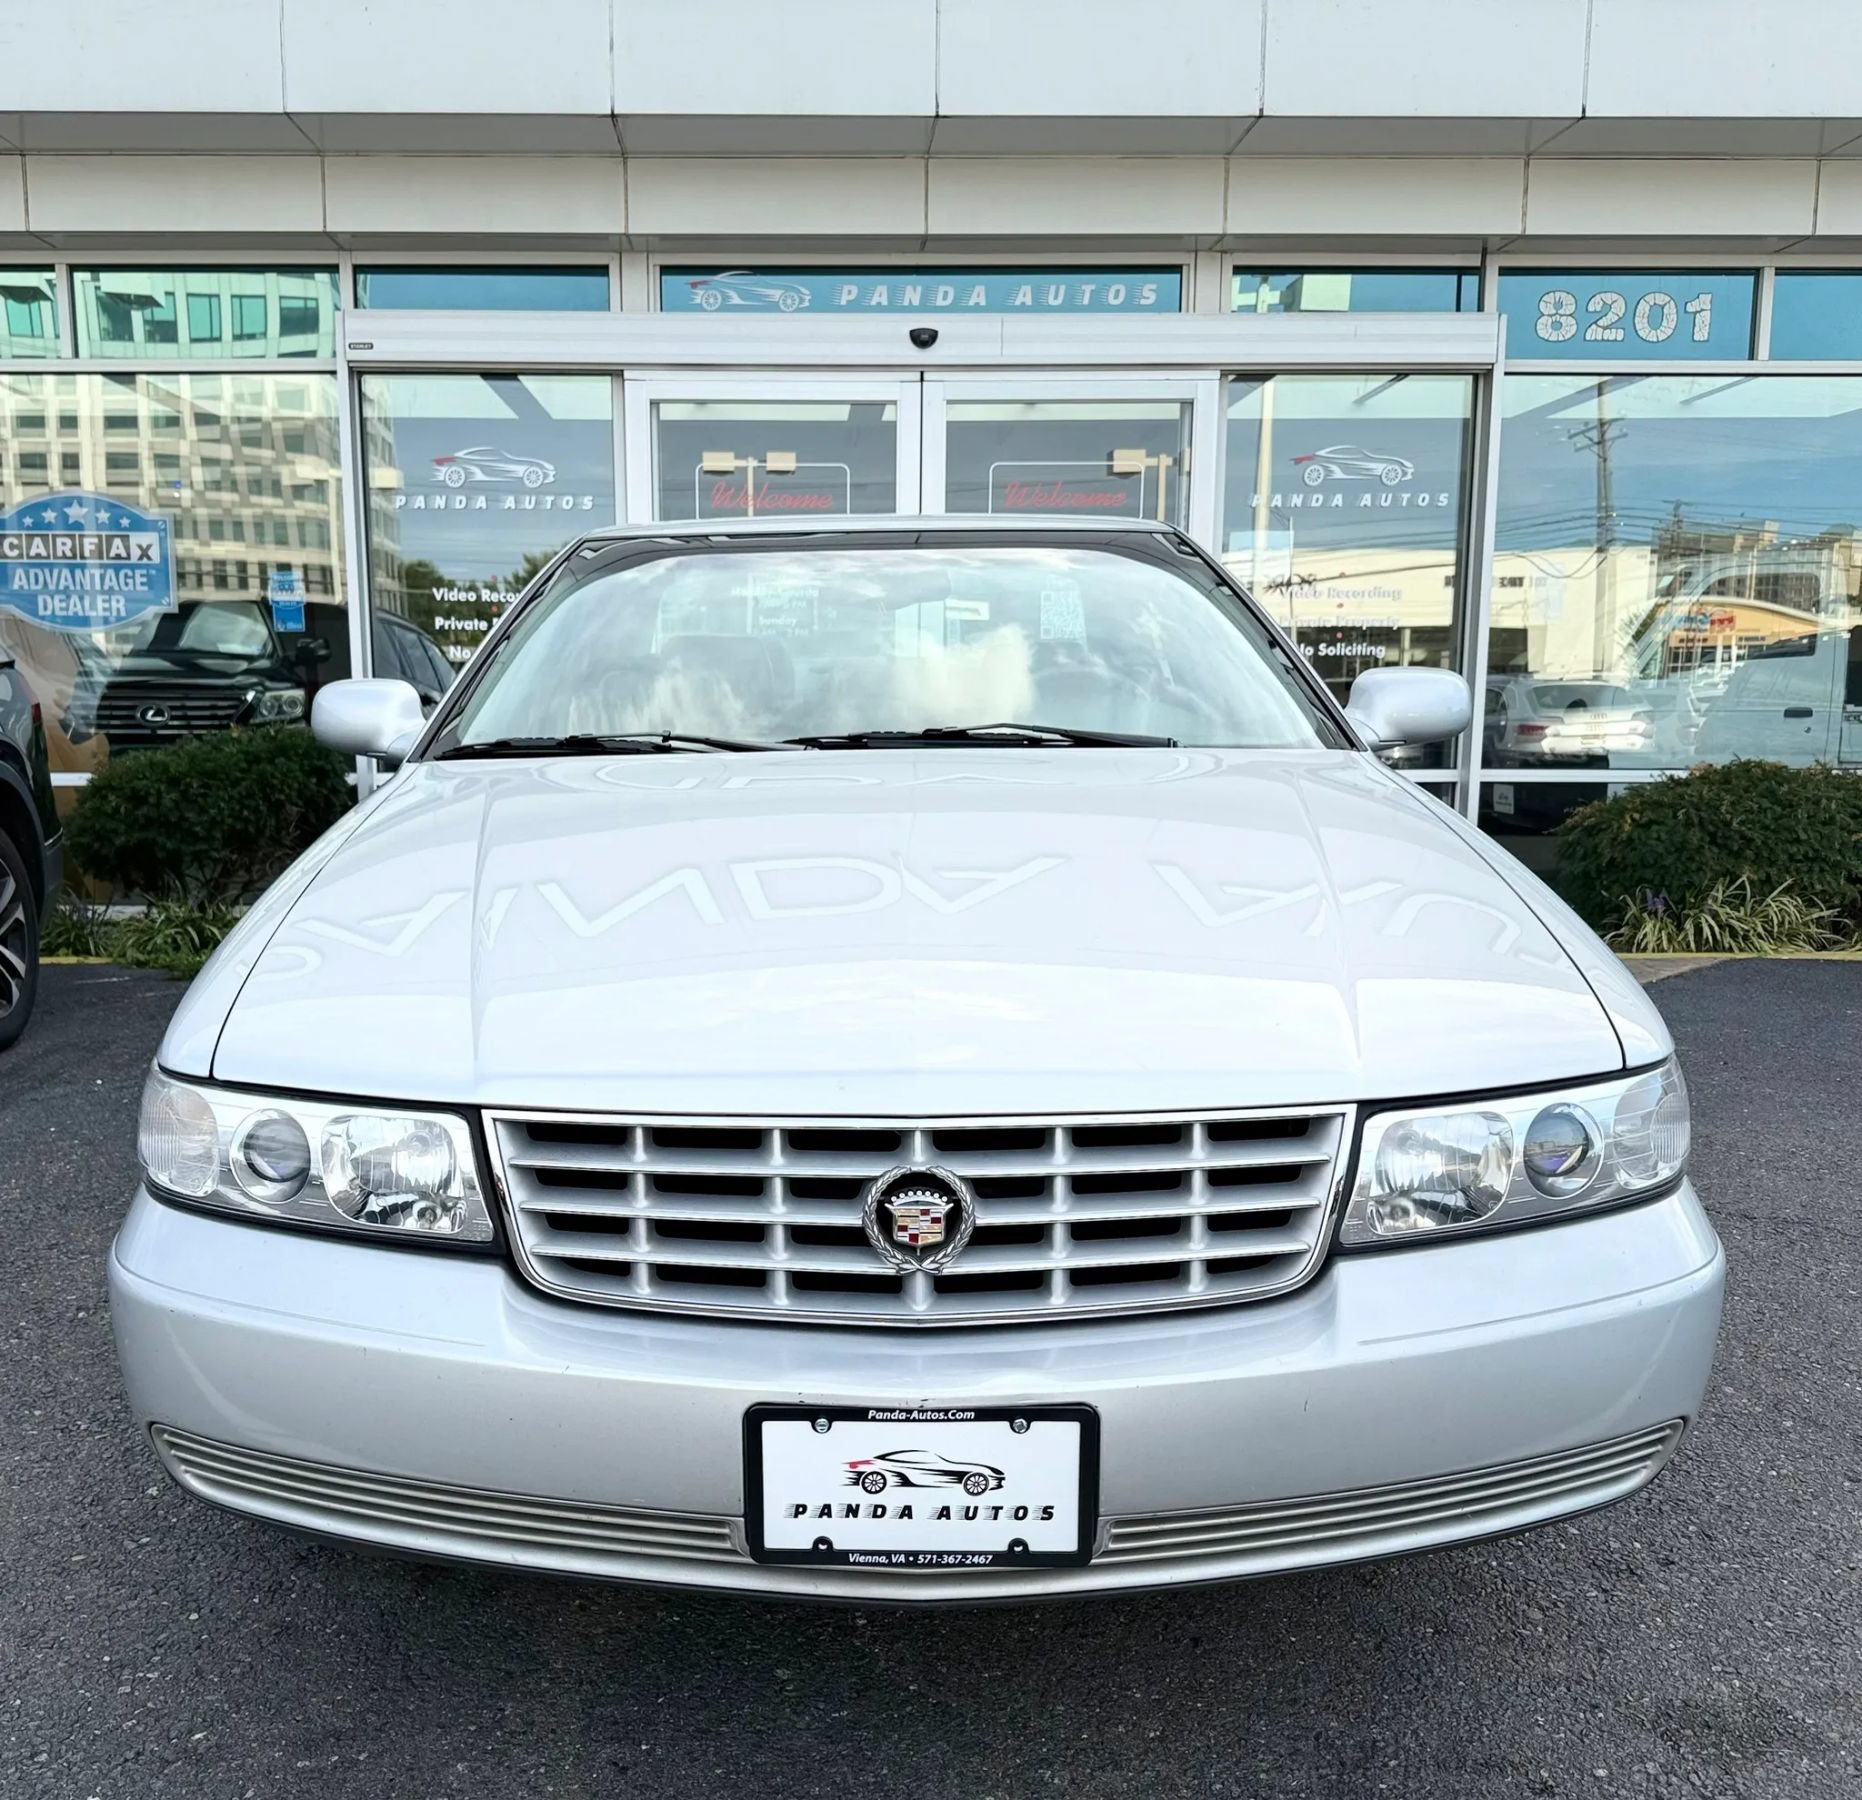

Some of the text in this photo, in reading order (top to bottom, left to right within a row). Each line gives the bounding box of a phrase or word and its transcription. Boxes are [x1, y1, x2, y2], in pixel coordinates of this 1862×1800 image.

[836, 283, 1158, 306] PANDA AUTOS
[1535, 289, 1713, 343] 8201
[395, 494, 594, 510] PANDA AUTOS
[711, 479, 833, 509] Welcome
[1004, 479, 1128, 508] Welcome
[1251, 492, 1450, 508] PANDA AUTOS
[2, 536, 153, 561] CARFAX
[12, 567, 149, 591] ADVANTAGE
[432, 587, 477, 602] Video
[1327, 586, 1404, 602] Recording
[37, 594, 127, 617] DEALER
[434, 616, 488, 631] Private
[450, 646, 471, 659] No
[1318, 642, 1386, 659] Soliciting
[867, 1409, 975, 1420] Panda-Autos.Com
[787, 1502, 1055, 1521] PANDA AUTOS
[848, 1553, 993, 1564] Vienna, VA 571-367-2467
